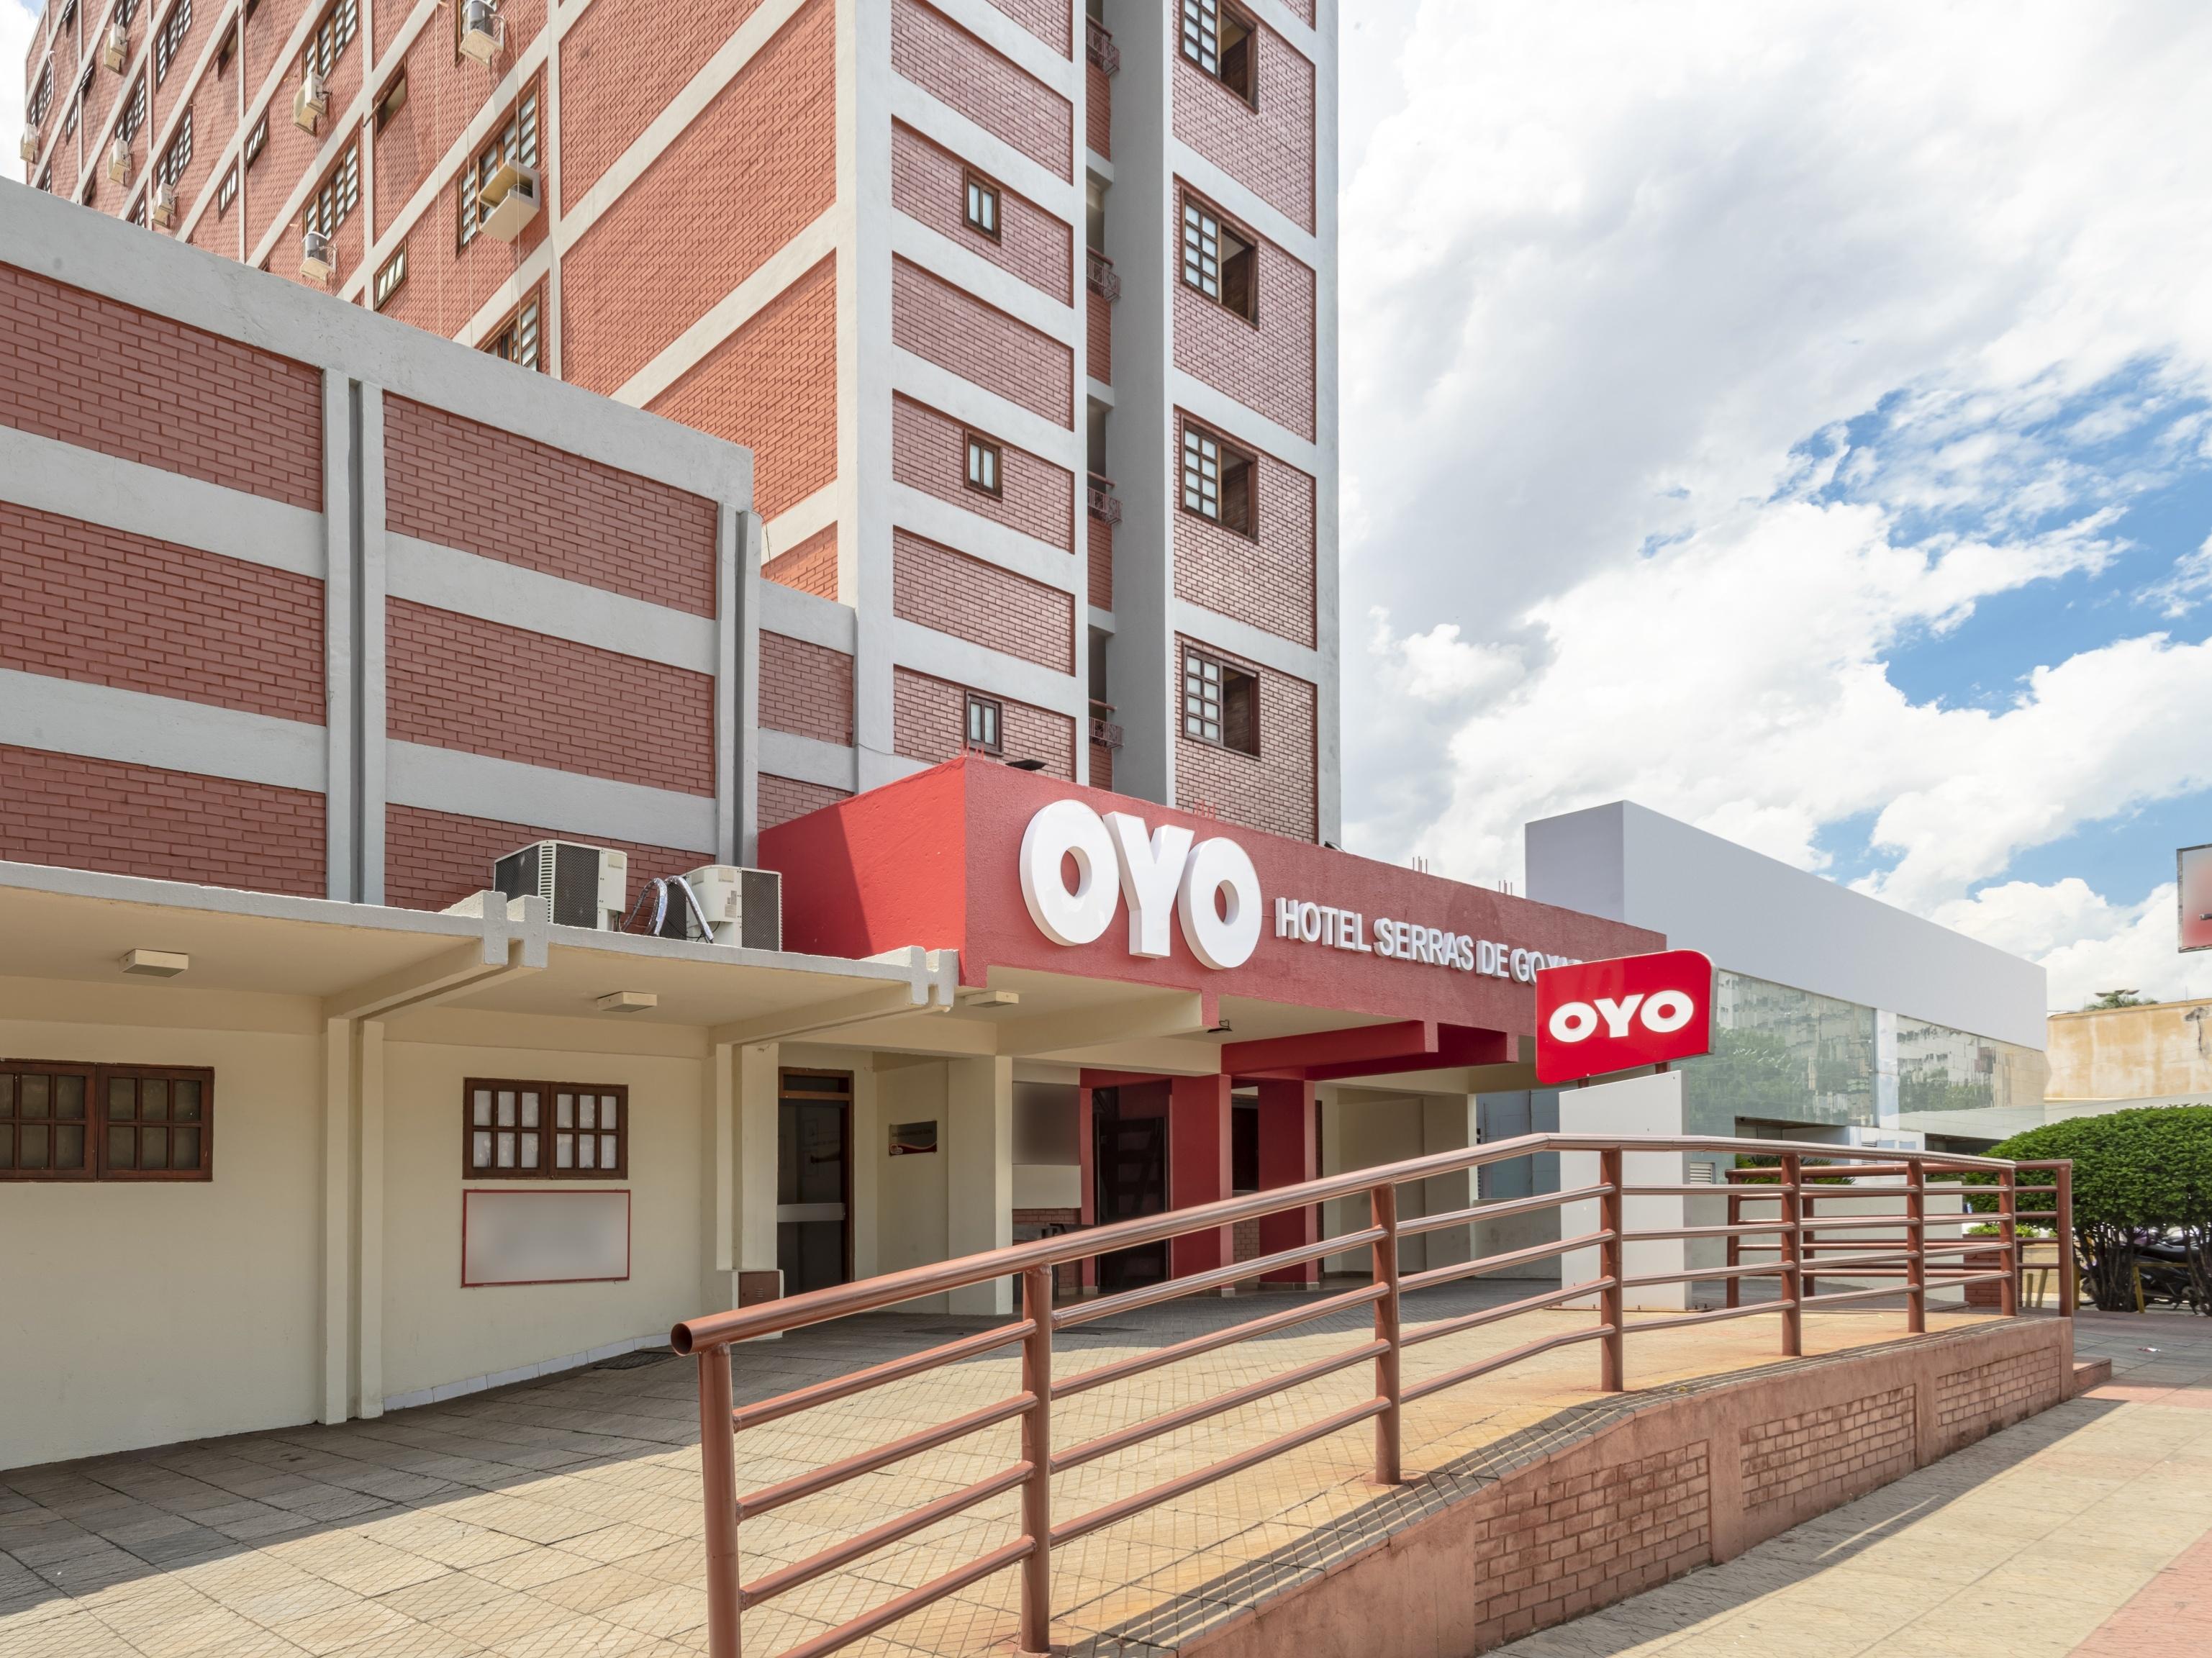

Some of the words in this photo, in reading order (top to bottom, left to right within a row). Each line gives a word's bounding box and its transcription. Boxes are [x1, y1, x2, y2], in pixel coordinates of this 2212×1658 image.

[1020, 799, 1262, 970] OYO
[1275, 897, 1371, 952] HOTEL
[1374, 918, 1474, 971] SERRAS
[1476, 940, 1509, 978] DE
[1549, 989, 1694, 1043] OYO
